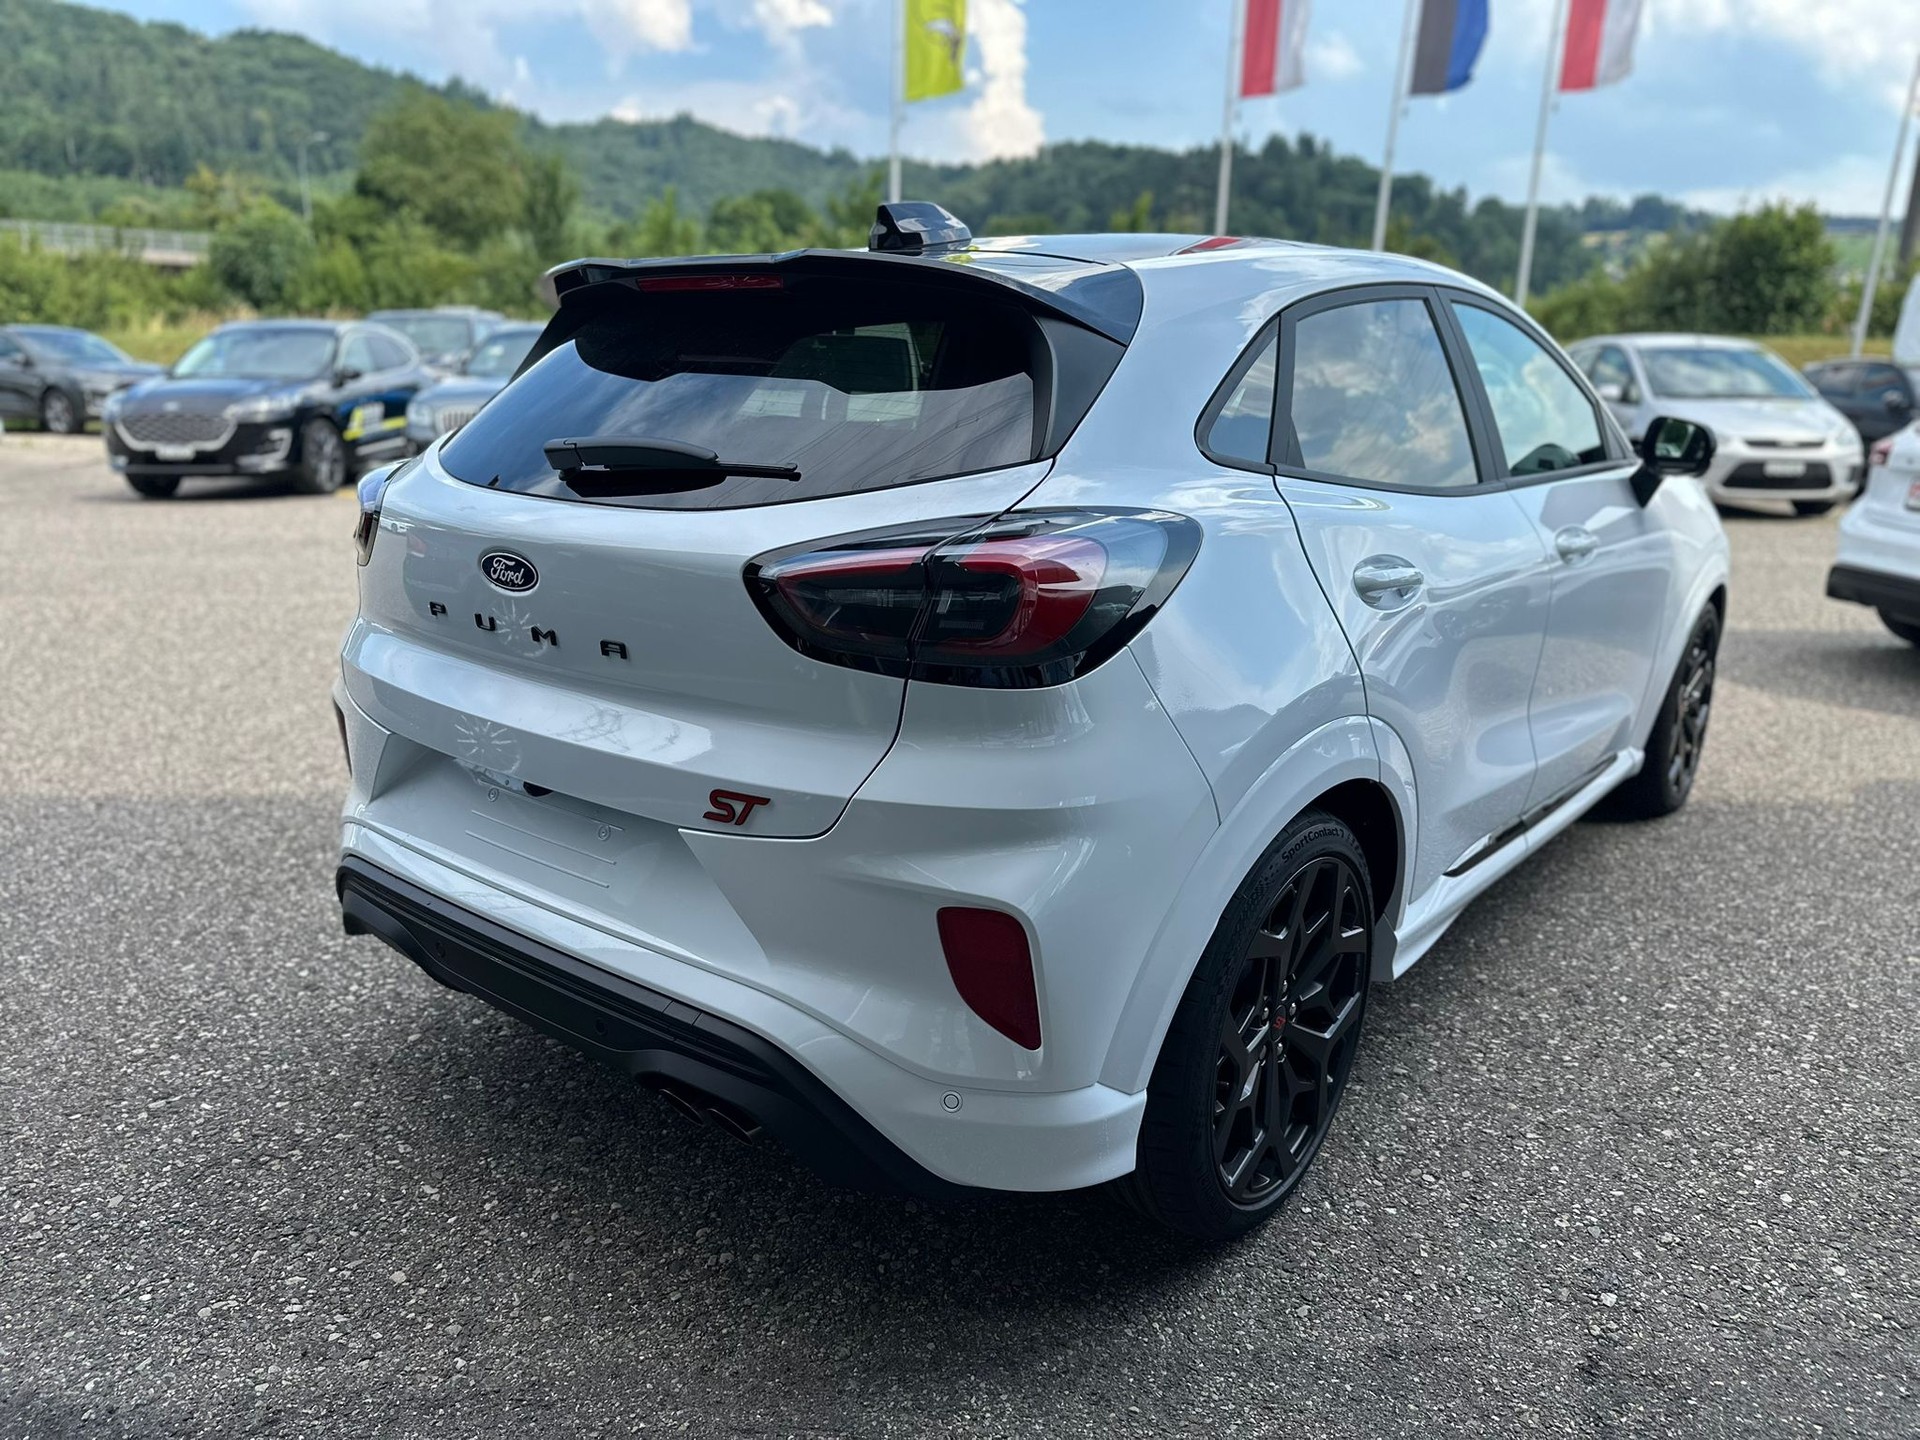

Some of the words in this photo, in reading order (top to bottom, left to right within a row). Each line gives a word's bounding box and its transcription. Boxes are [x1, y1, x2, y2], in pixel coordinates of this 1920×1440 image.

[490, 557, 524, 585] Ford
[429, 601, 628, 660] PUMA
[703, 789, 771, 825] ST
